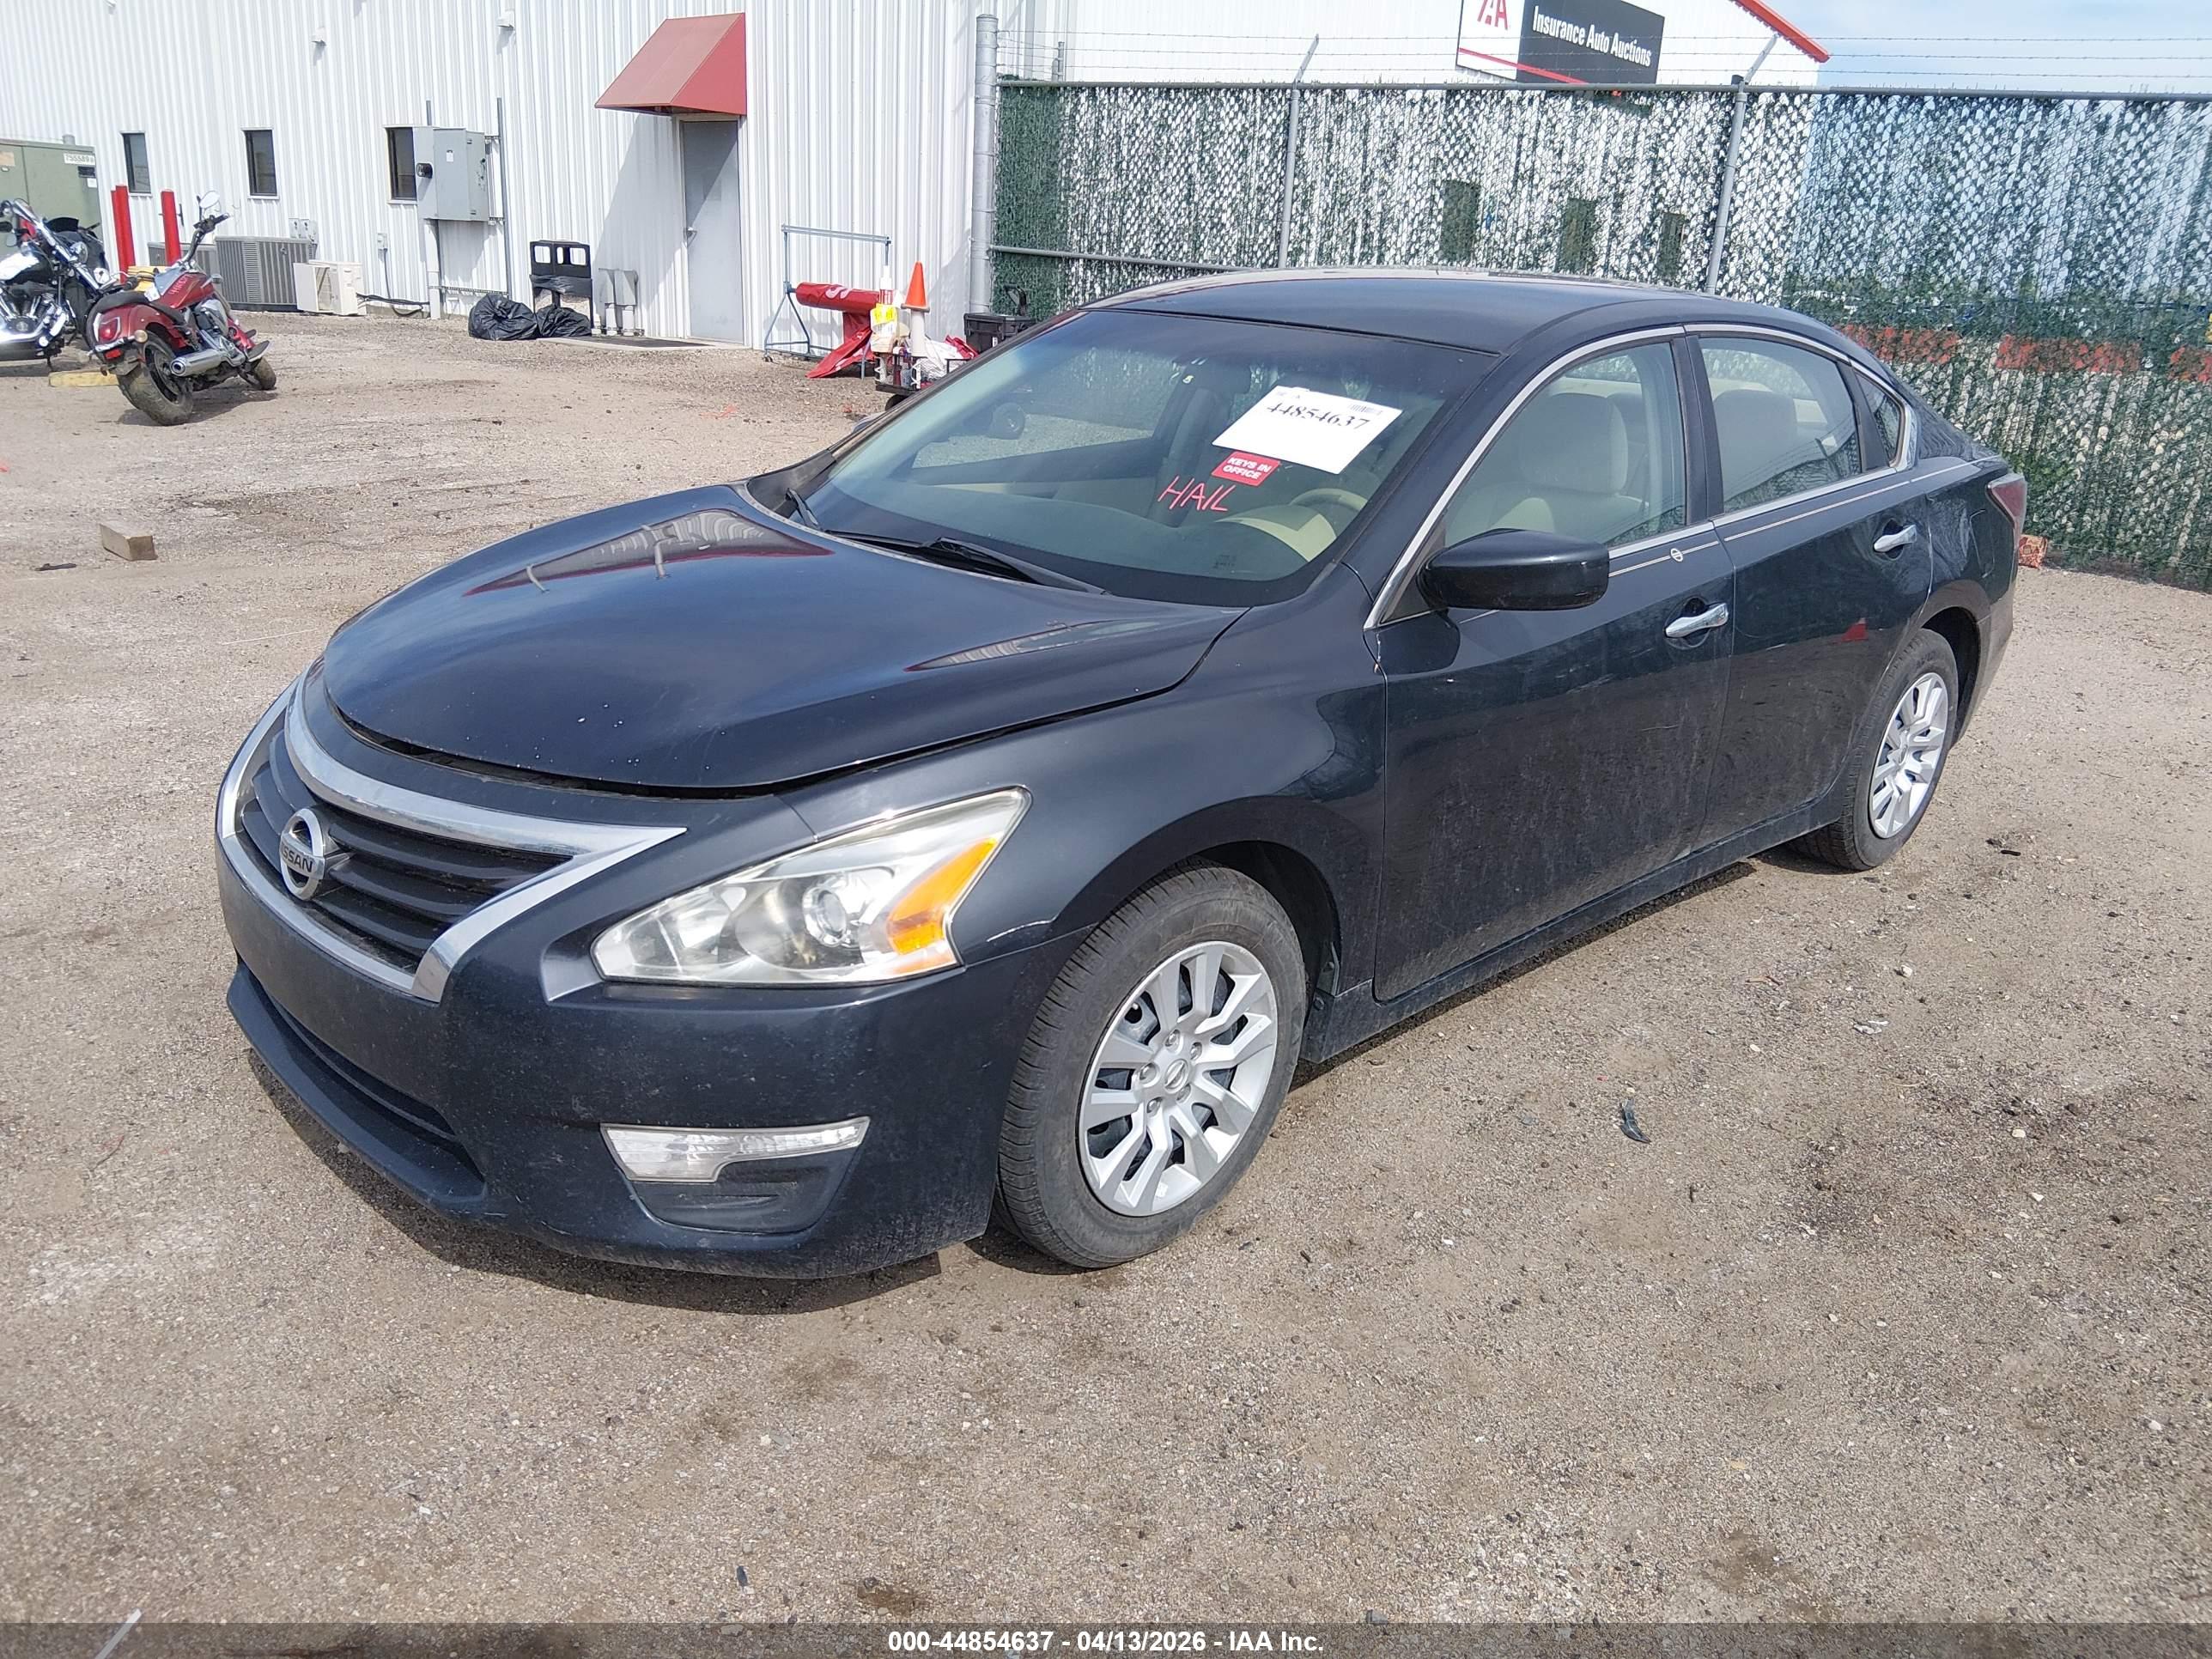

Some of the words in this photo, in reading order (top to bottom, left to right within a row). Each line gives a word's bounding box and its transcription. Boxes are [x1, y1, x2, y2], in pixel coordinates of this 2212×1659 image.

[1532, 5, 1586, 46] Insurance
[1586, 24, 1610, 53] Auto
[1610, 32, 1652, 67] Auctions
[1267, 402, 1370, 429] 44854637
[1223, 465, 1261, 480] OFFICE
[1227, 458, 1257, 469] KEYS
[1257, 464, 1272, 472] IN
[1157, 475, 1237, 511] HAIL
